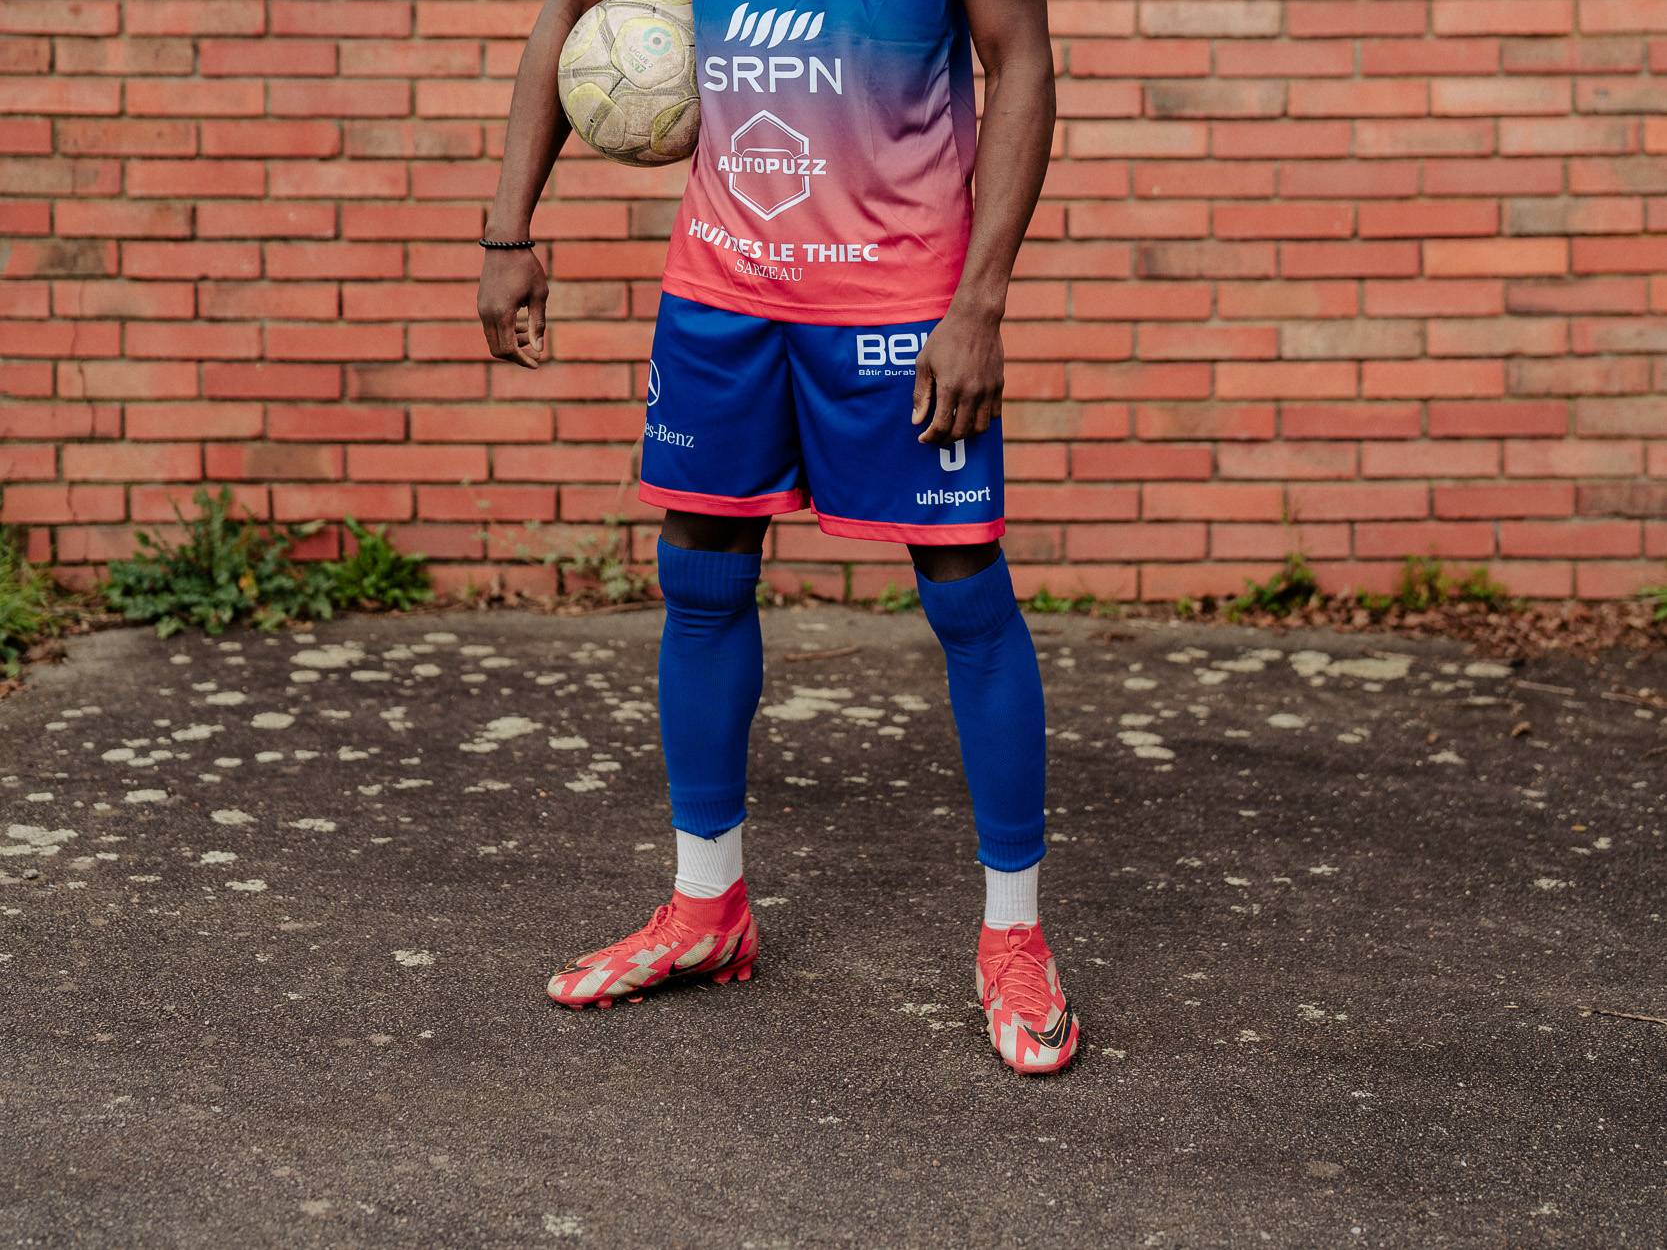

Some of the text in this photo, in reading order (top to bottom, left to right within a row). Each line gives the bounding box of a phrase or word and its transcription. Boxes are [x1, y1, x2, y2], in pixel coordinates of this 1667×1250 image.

[703, 56, 843, 95] SRPN
[717, 155, 827, 175] AUTOPUZZ
[769, 242, 795, 262] LE
[802, 243, 880, 262] THIEC
[735, 258, 803, 282] SARZEAU
[916, 486, 991, 507] uhlsport
